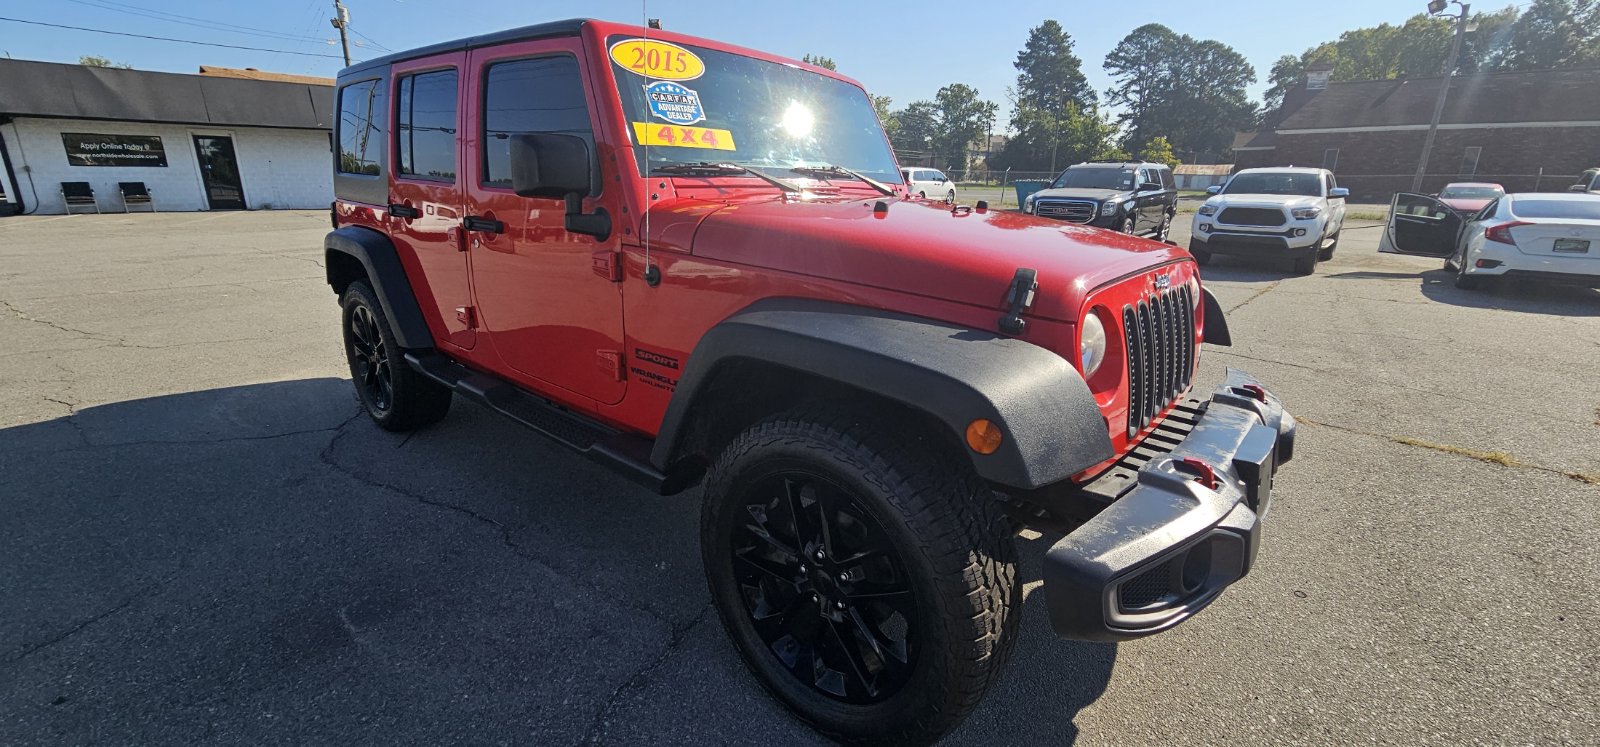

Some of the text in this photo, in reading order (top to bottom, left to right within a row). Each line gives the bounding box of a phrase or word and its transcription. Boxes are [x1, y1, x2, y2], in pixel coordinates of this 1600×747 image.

[631, 47, 687, 73] 2015
[651, 93, 696, 105] CARFAX
[658, 103, 697, 114] ADVANTAGE
[667, 112, 693, 120] DEALER
[80, 142, 99, 150] Apply
[101, 142, 122, 150] Online
[635, 349, 679, 368] SPORT
